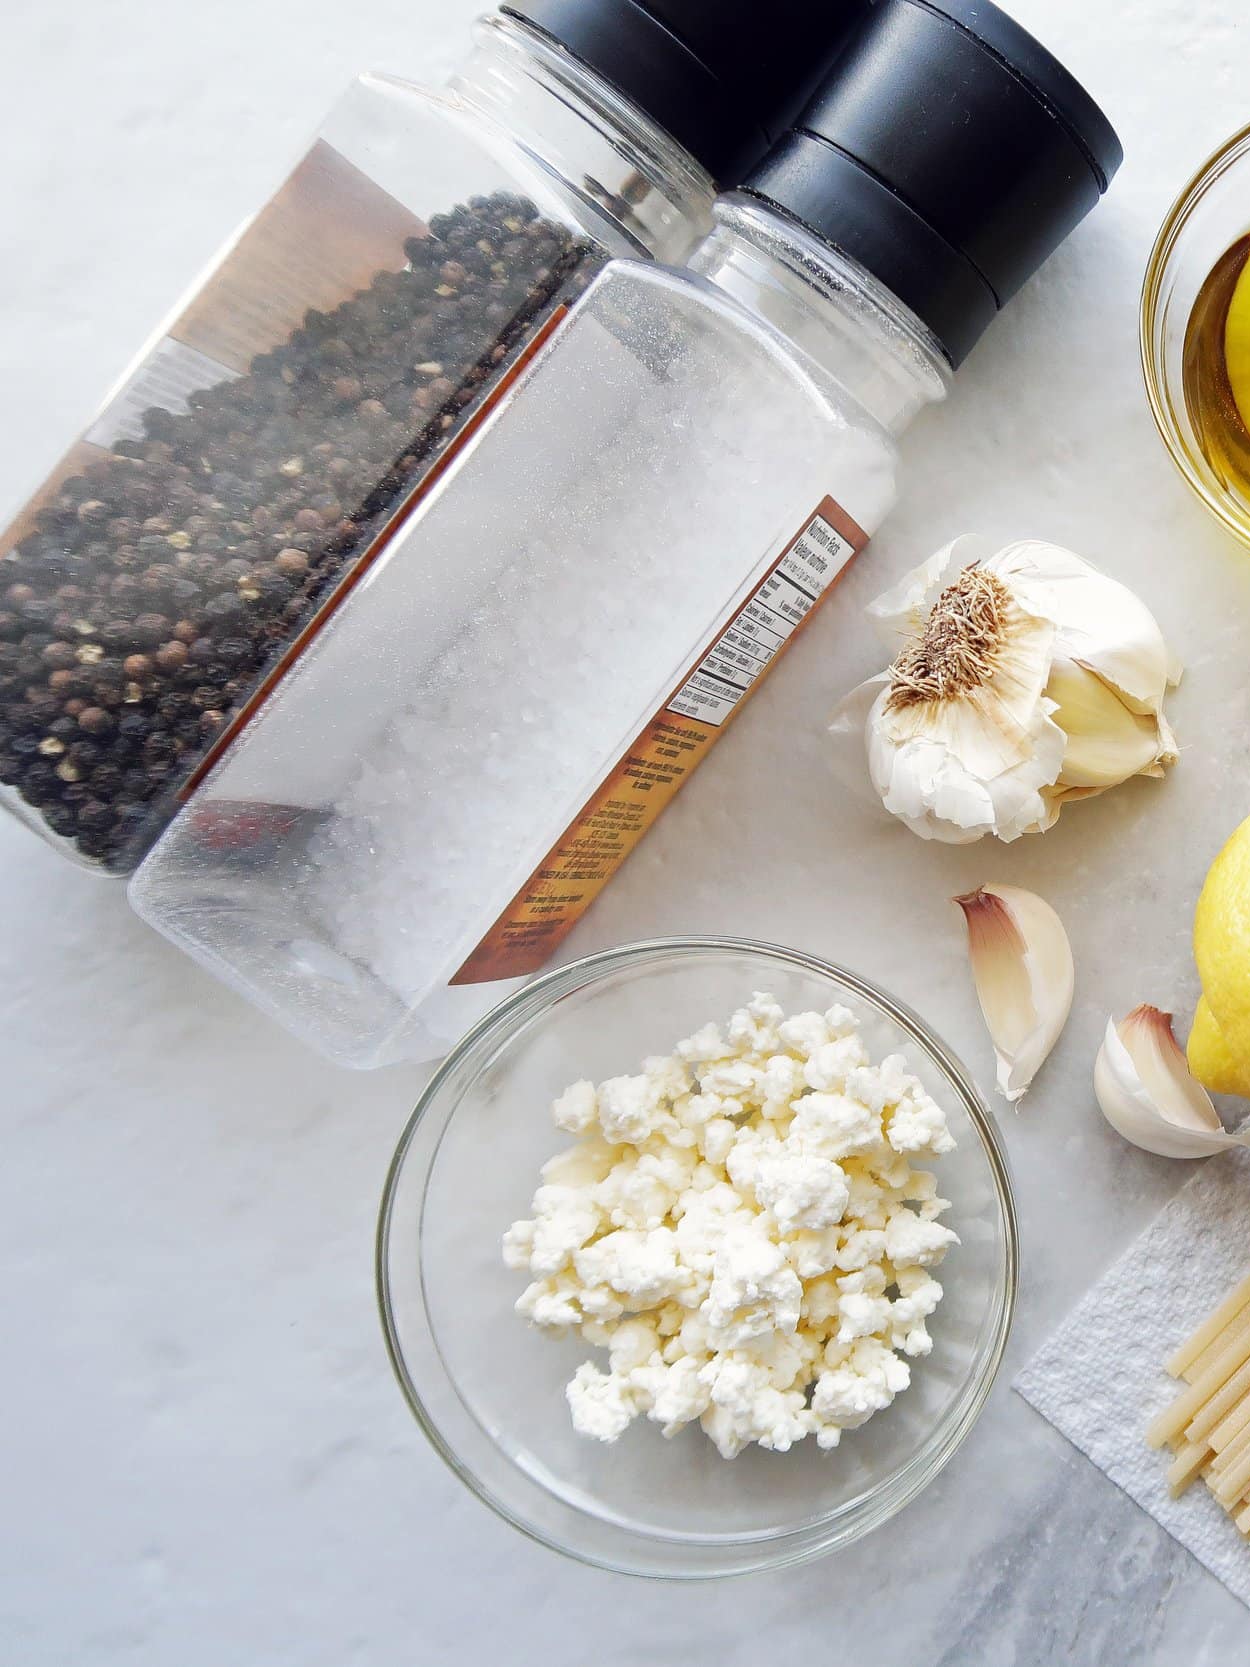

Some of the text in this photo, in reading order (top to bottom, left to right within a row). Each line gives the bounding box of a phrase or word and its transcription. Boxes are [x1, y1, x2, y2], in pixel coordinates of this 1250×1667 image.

[807, 519, 841, 556] Nutrition Facts
[793, 538, 828, 574] Valeur nutritive
